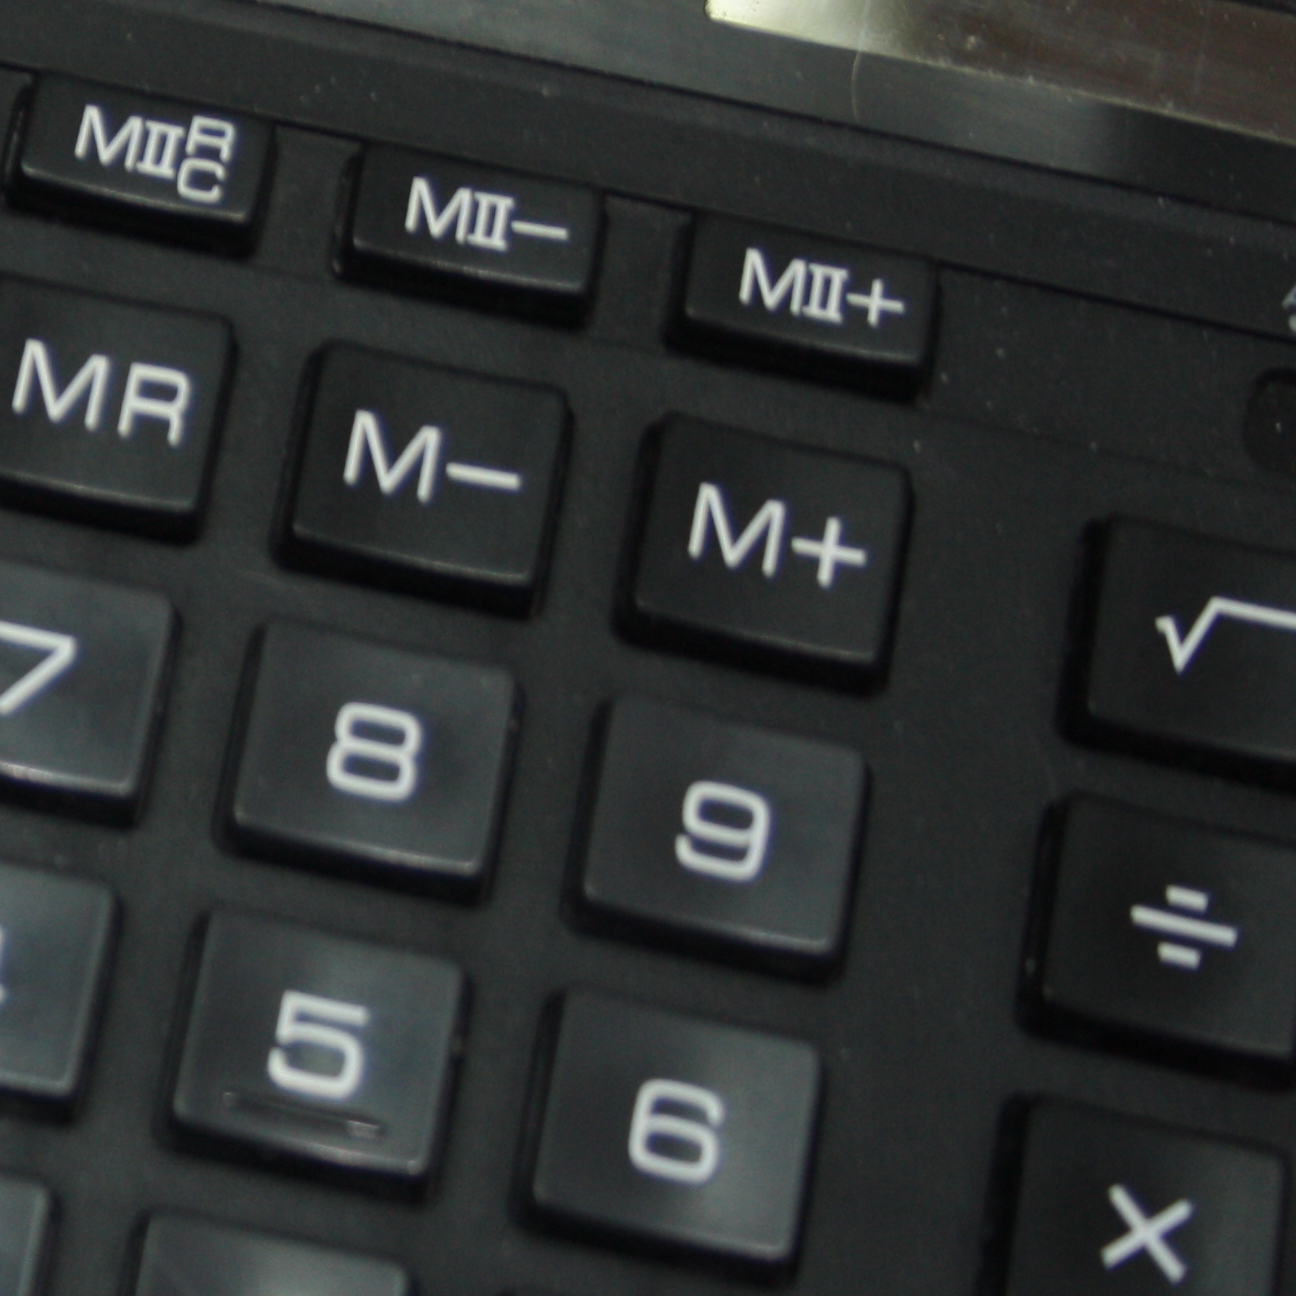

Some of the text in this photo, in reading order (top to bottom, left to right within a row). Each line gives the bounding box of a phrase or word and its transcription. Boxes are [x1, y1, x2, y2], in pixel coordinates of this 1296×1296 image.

[12, 338, 193, 448] MR
[688, 481, 867, 589] M+
[325, 700, 423, 802] 8
[675, 779, 772, 882] 9
[266, 988, 369, 1100] 5
[627, 1077, 725, 1184] 6
